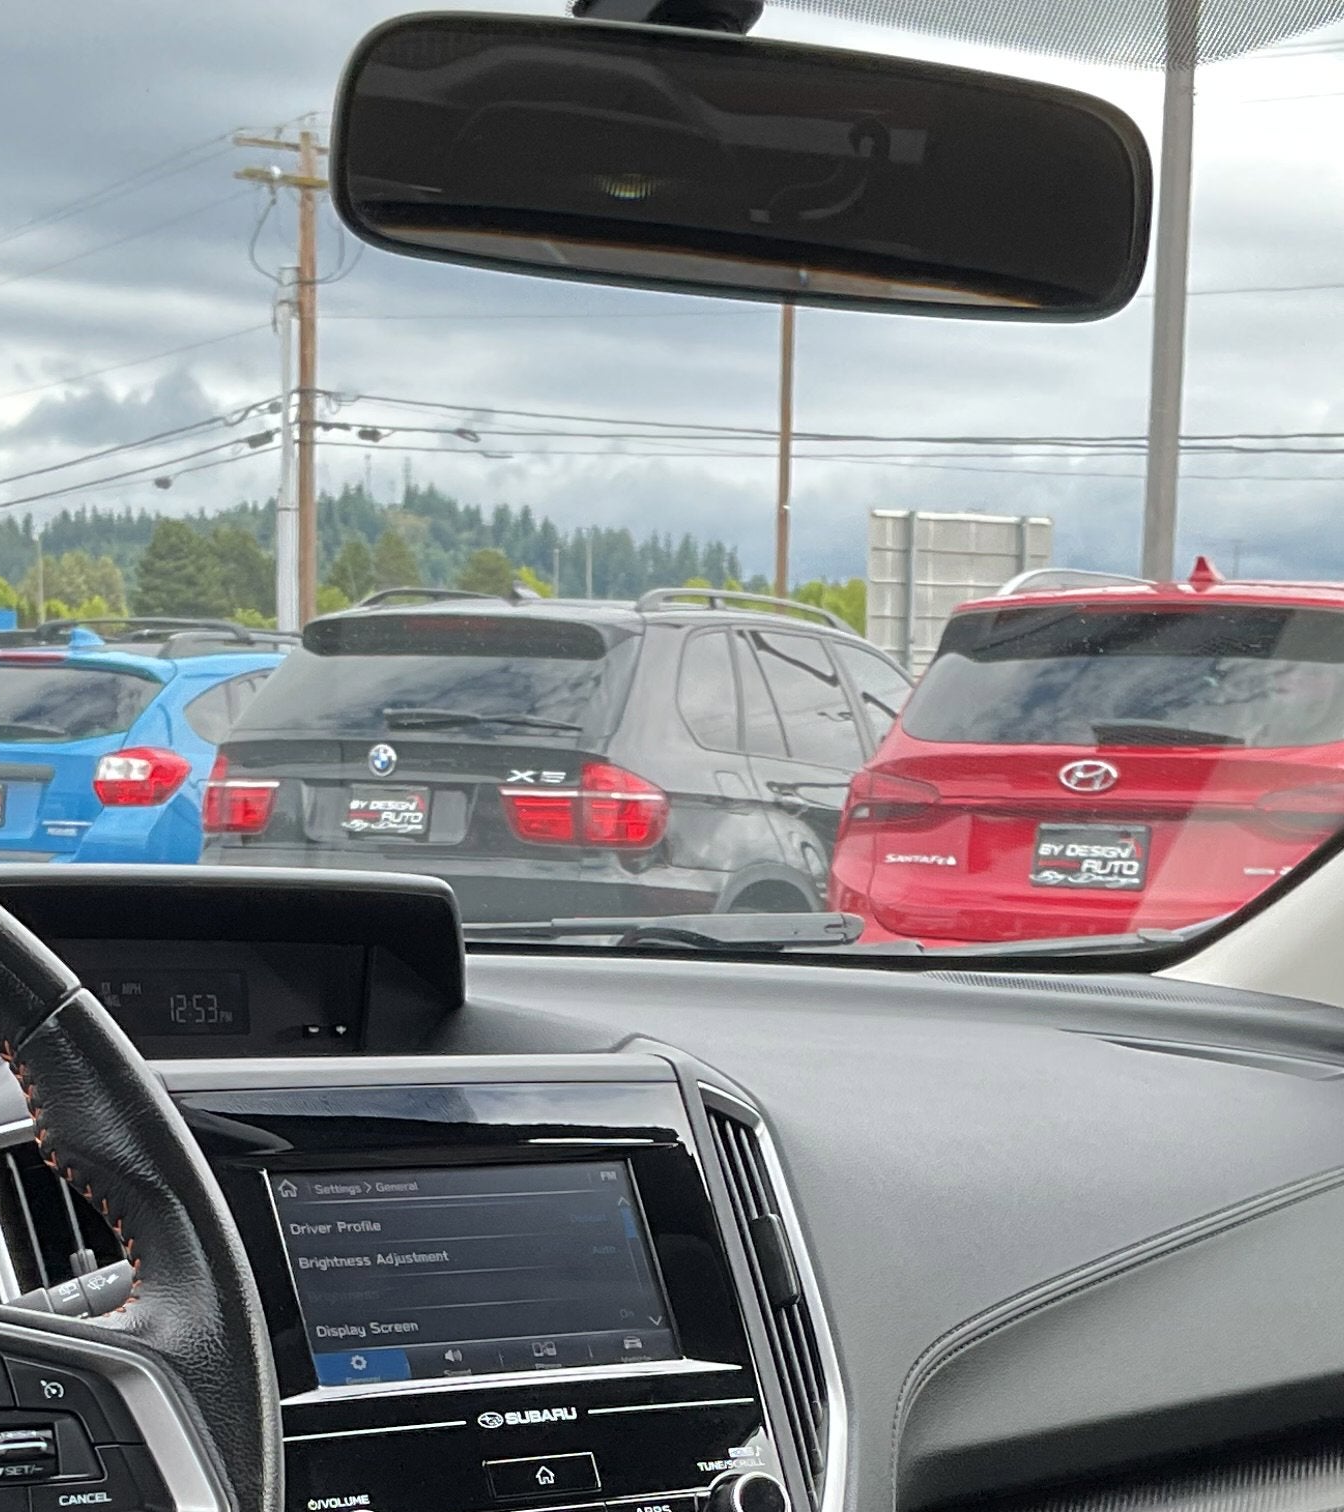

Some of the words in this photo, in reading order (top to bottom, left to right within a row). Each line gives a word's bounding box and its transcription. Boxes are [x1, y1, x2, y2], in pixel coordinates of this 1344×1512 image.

[506, 769, 566, 783] X5
[350, 800, 367, 810] BY
[369, 800, 417, 811] DESIGN
[381, 811, 423, 823] AUTO
[1038, 843, 1064, 856] BY
[1065, 844, 1133, 858] DESIGN
[1080, 859, 1139, 875] AUTO
[600, 1170, 618, 1182] FM
[314, 1182, 362, 1196] Settings
[375, 1180, 418, 1193] General
[289, 1221, 332, 1236] Driver
[337, 1219, 382, 1233] Profile
[298, 1254, 372, 1272] Brightness
[376, 1249, 450, 1267] Adjustment
[315, 1323, 367, 1341] Display
[370, 1319, 419, 1334] Screen
[505, 1407, 577, 1425] SUBARU
[59, 1491, 113, 1506] CANCEL
